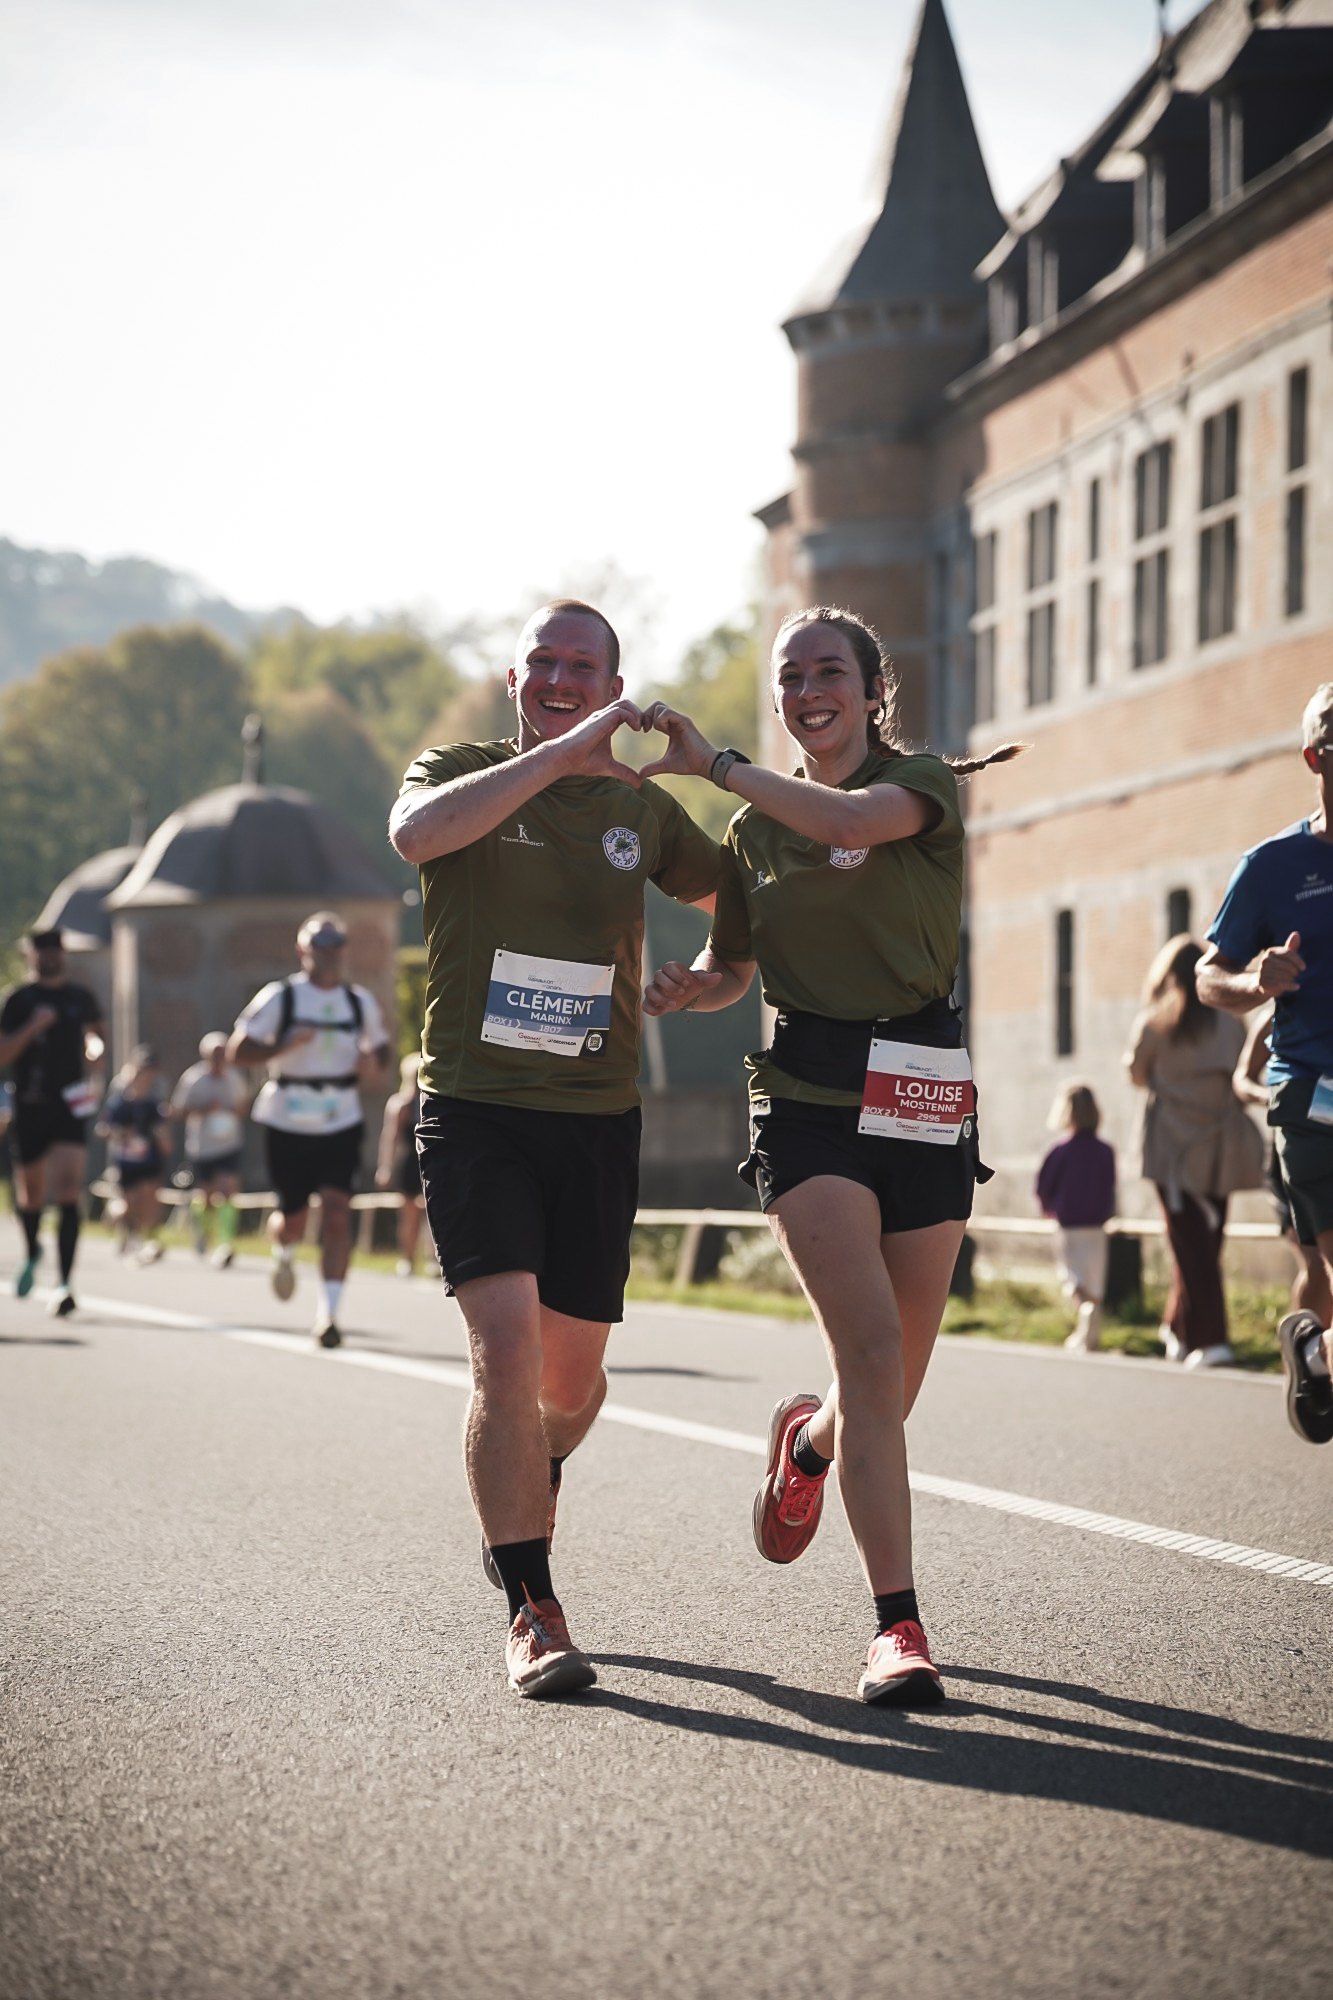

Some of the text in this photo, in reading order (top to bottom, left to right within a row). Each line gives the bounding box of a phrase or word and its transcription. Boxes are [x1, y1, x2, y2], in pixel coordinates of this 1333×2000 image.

[618, 830, 631, 840] DES
[507, 990, 594, 1015] CLÉMENT
[487, 1014, 507, 1026] BOX
[530, 1012, 572, 1025] MARINX
[539, 1024, 562, 1034] 1807
[895, 1080, 963, 1102] LOUISE
[863, 1106, 891, 1117] BOX 2
[900, 1099, 957, 1113] MOSTENNE
[916, 1113, 941, 1122] 2996
